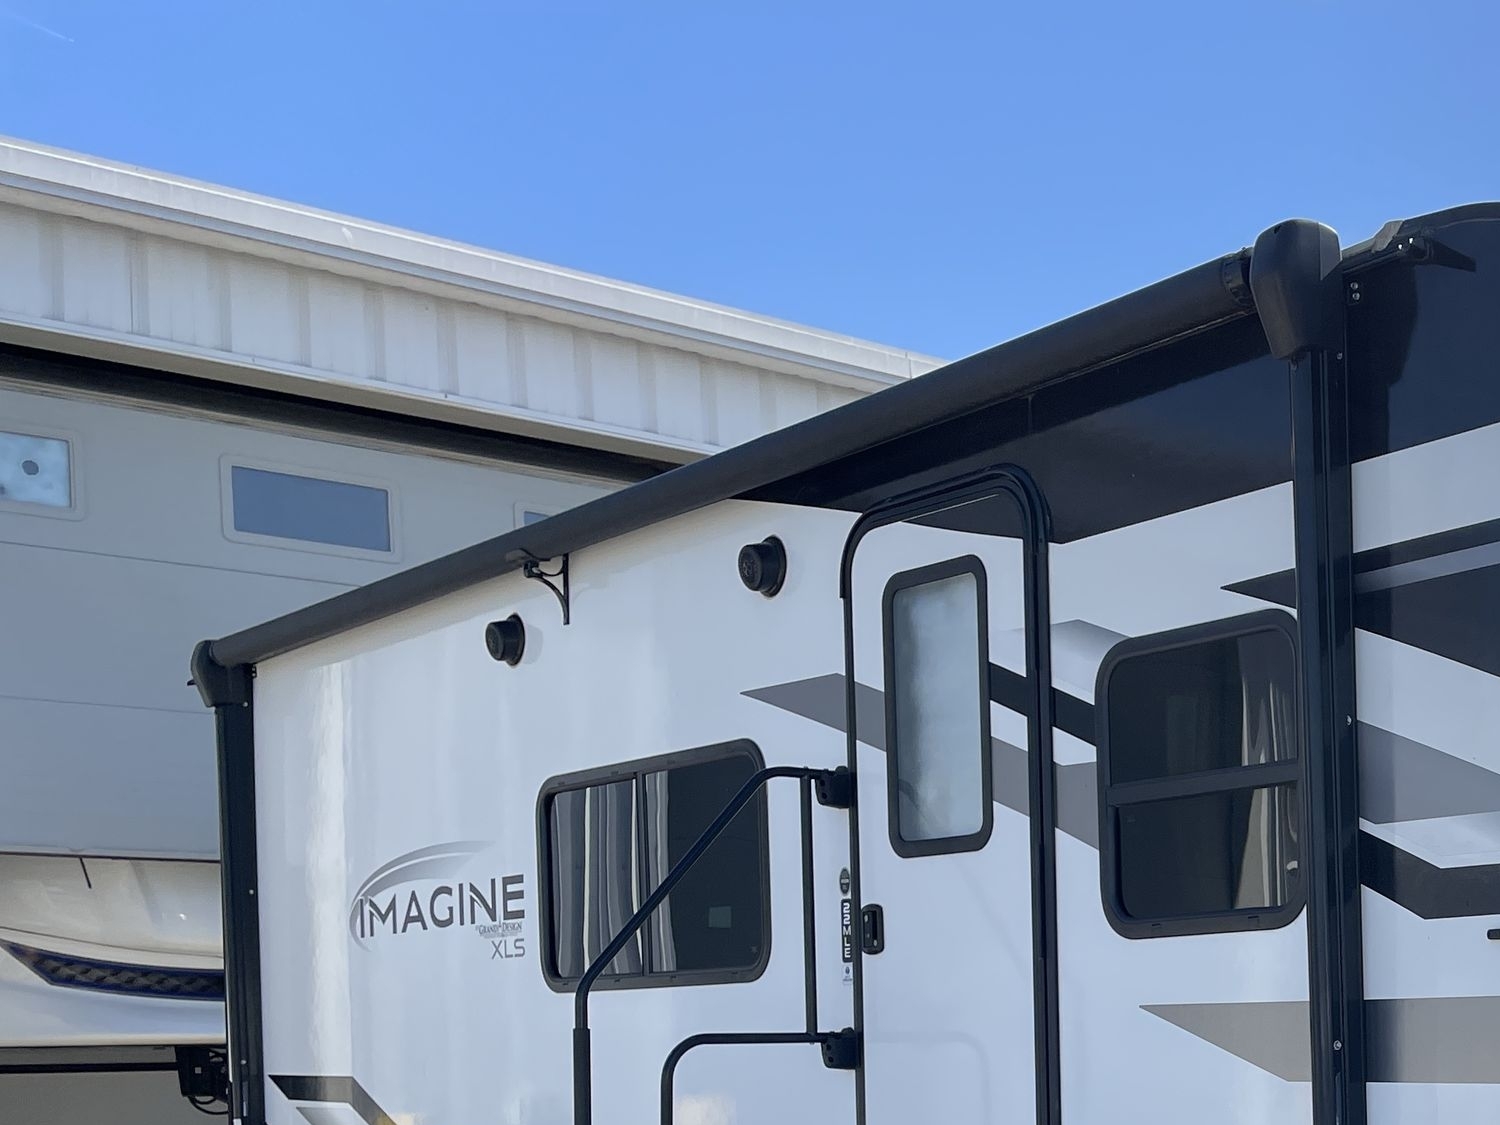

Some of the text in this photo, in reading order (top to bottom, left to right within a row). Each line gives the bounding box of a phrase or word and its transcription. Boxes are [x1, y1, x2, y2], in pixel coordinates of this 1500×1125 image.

[359, 874, 525, 938] IMAGINE
[843, 902, 851, 958] 22MLE
[491, 938, 526, 960] XLS
